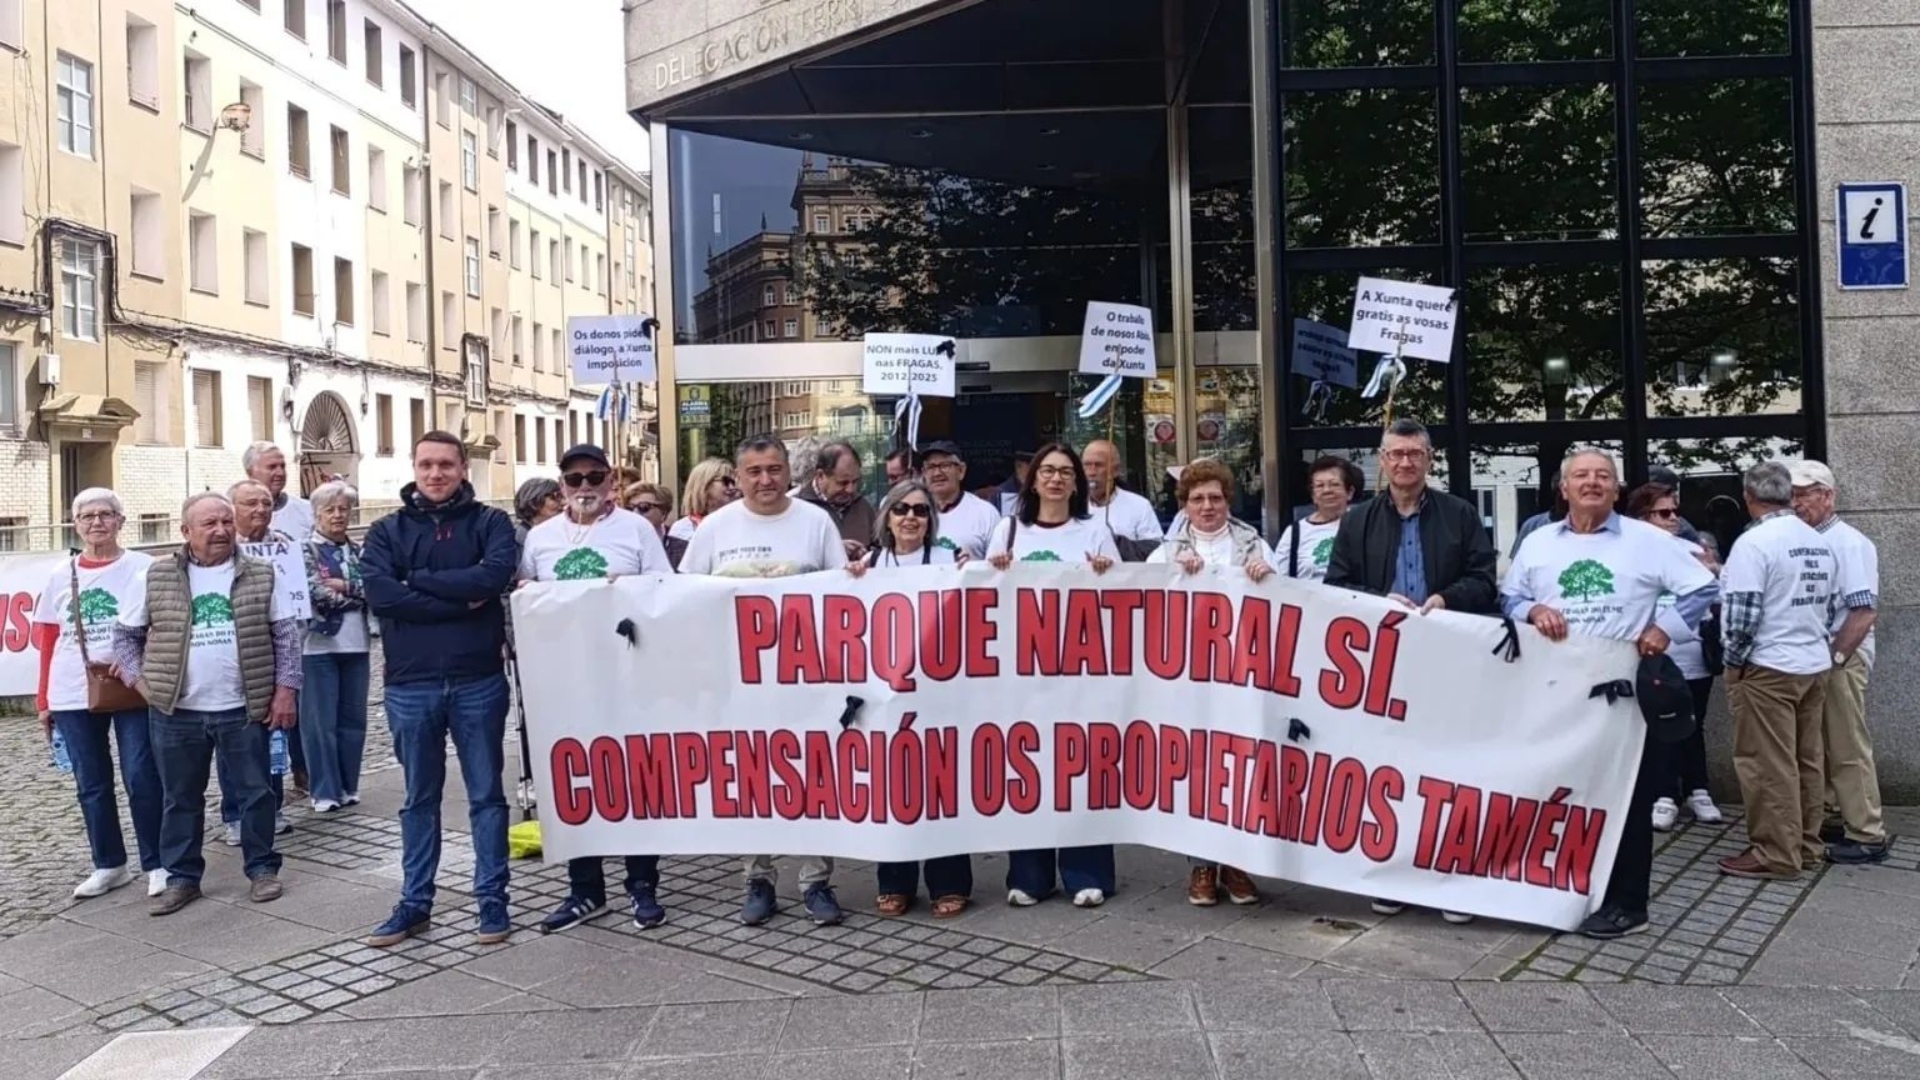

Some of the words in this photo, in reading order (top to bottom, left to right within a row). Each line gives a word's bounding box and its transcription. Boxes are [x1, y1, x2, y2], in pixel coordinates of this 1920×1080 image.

[1361, 290, 1370, 301] A
[1374, 291, 1412, 306] Xunta
[1106, 311, 1116, 321] O
[1356, 309, 1393, 321] gratis
[1396, 314, 1410, 324] as
[1414, 316, 1449, 330] vosas
[574, 330, 588, 340] Os
[590, 330, 621, 340] donos
[623, 328, 646, 339] pide
[1091, 326, 1105, 336] de
[1107, 330, 1135, 339] nosos
[1380, 327, 1423, 344] Fragas
[627, 344, 652, 352] Xunta
[867, 345, 892, 354] NON
[894, 345, 920, 354] mais
[1105, 344, 1118, 352] en
[1120, 345, 1145, 356] poder
[1102, 357, 1116, 367] da
[1118, 358, 1145, 370] Xunta
[734, 588, 999, 692] PARQUE
[1017, 588, 1302, 698] NATURAL
[1318, 610, 1409, 721] SÍ.
[550, 711, 958, 826] COMPENSACIÓN
[971, 720, 1041, 817] OS
[1054, 720, 1405, 862] PROPIETARIOS
[1413, 786, 1607, 896] TAMÉN
